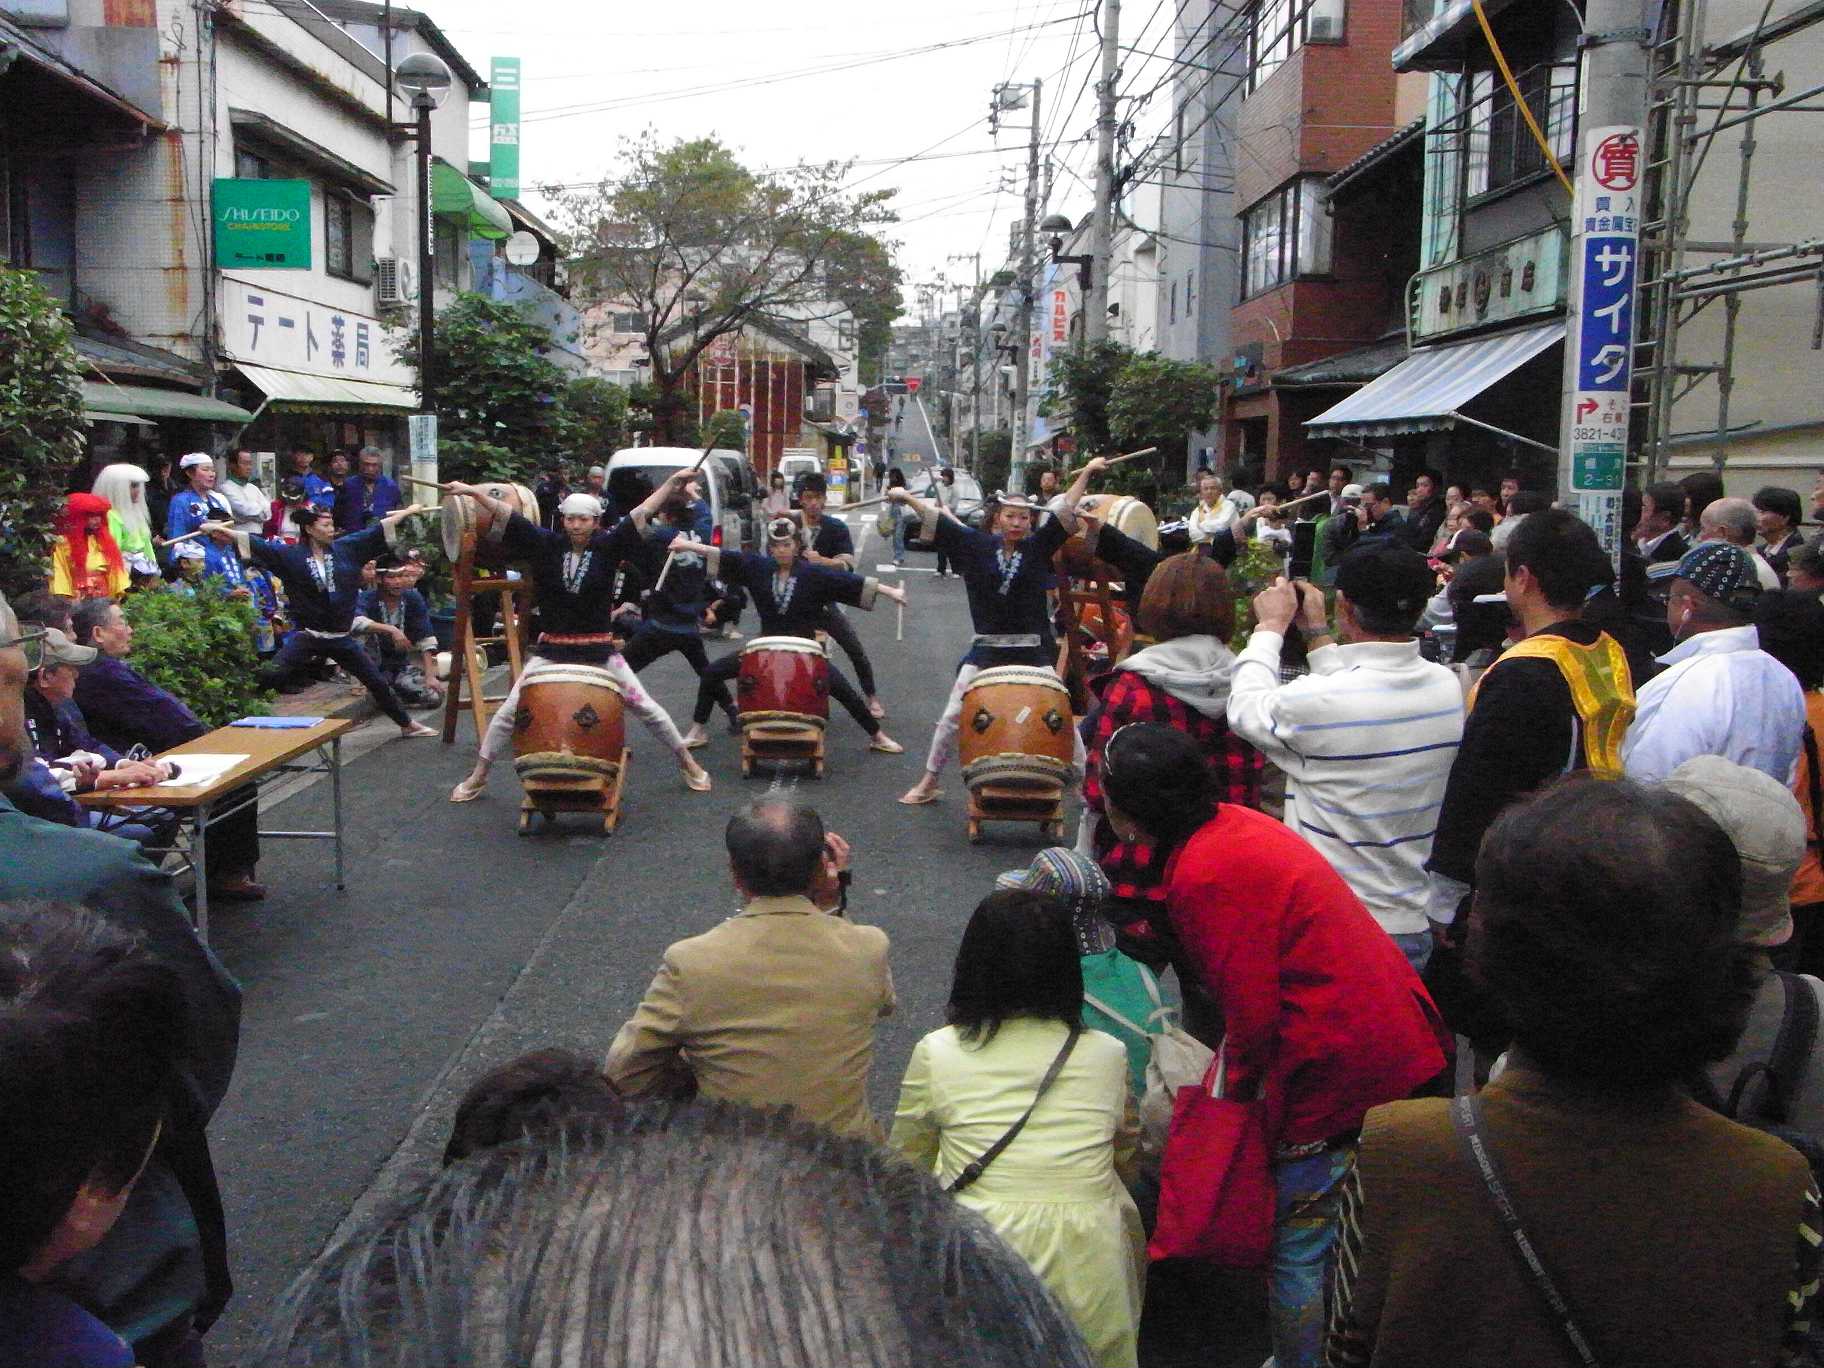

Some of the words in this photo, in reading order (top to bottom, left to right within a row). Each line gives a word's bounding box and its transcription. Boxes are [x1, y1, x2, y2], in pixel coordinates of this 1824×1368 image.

[1597, 138, 1639, 187] 質
[219, 206, 300, 222] SHISEIDO
[247, 294, 370, 370] テート薬局
[1591, 245, 1632, 385] サイタ
